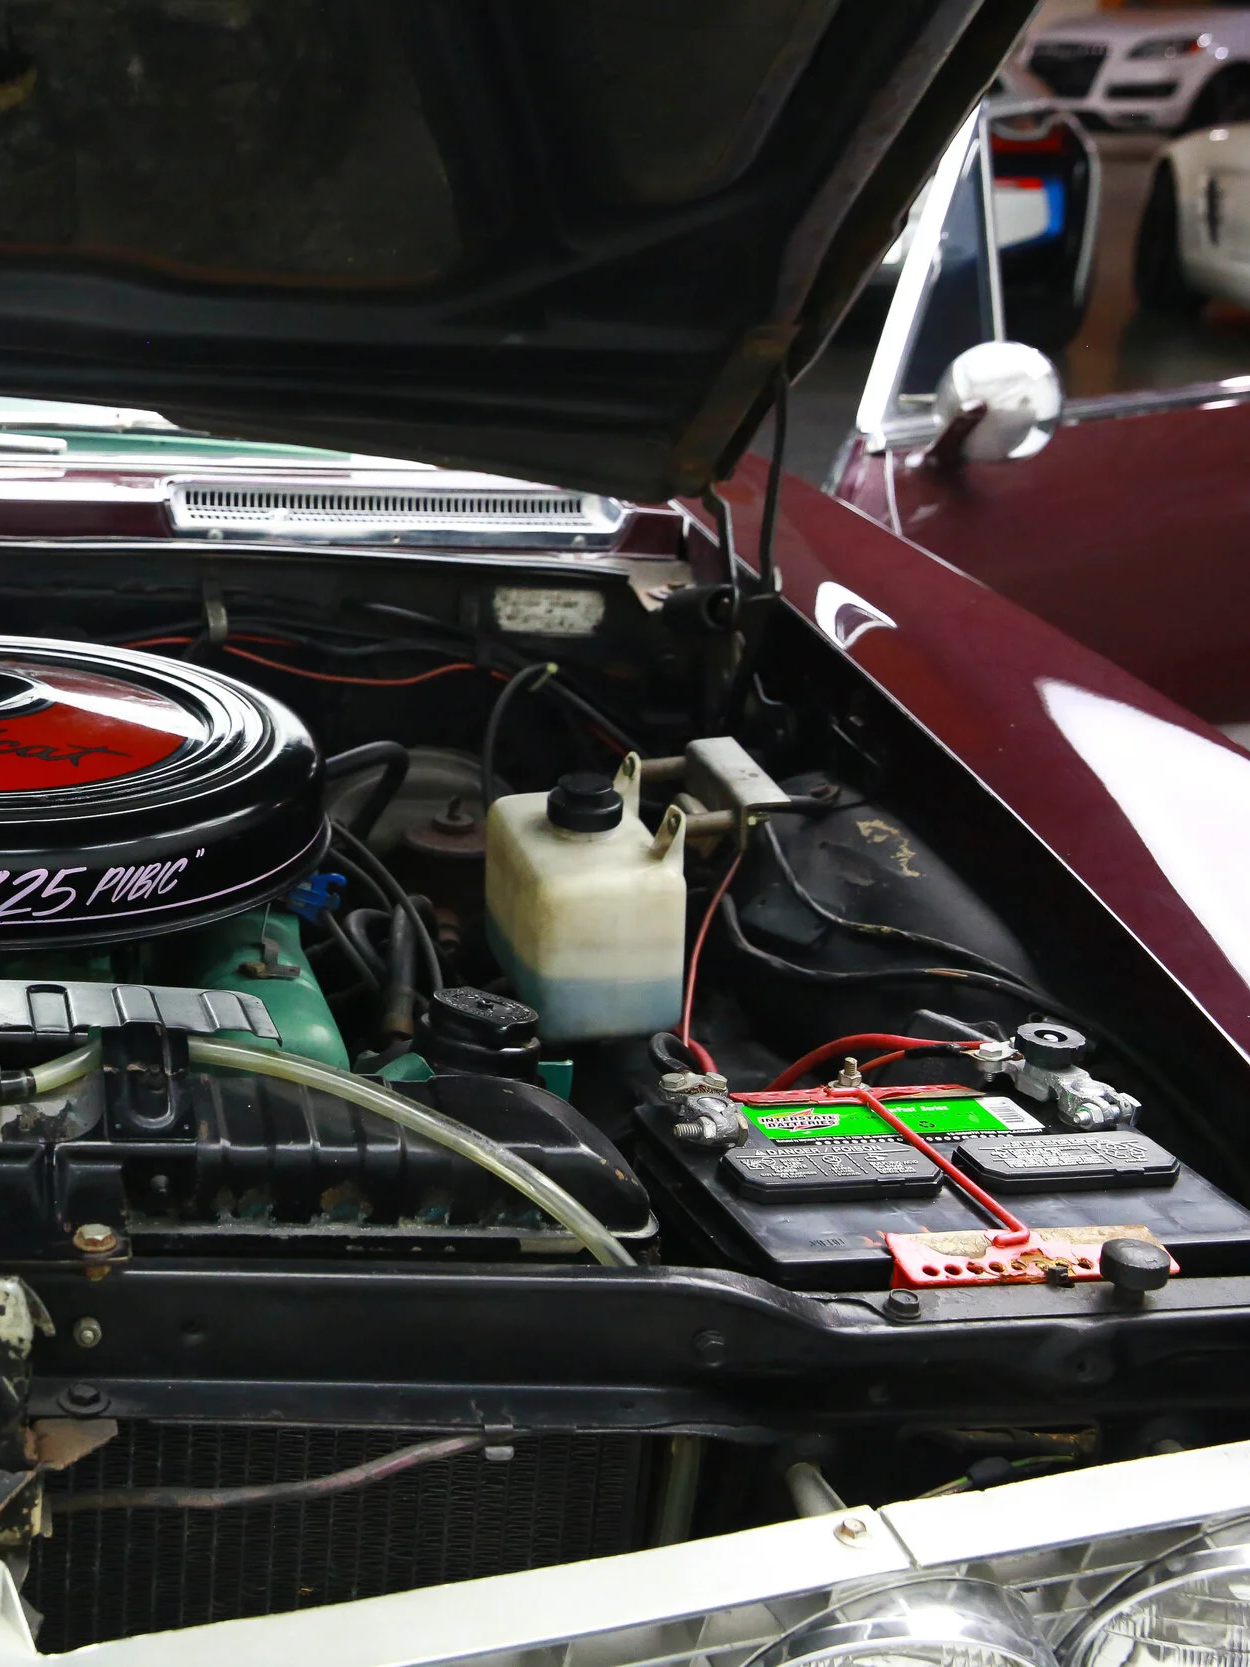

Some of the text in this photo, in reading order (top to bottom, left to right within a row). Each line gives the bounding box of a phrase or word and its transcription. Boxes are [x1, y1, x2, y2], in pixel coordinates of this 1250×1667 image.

[920, 1104, 949, 1112] Series
[760, 1114, 836, 1123] INTERSTATE
[768, 1120, 836, 1128] BATTERIES
[767, 1147, 820, 1156] DANGER
[834, 1145, 882, 1154] POISON
